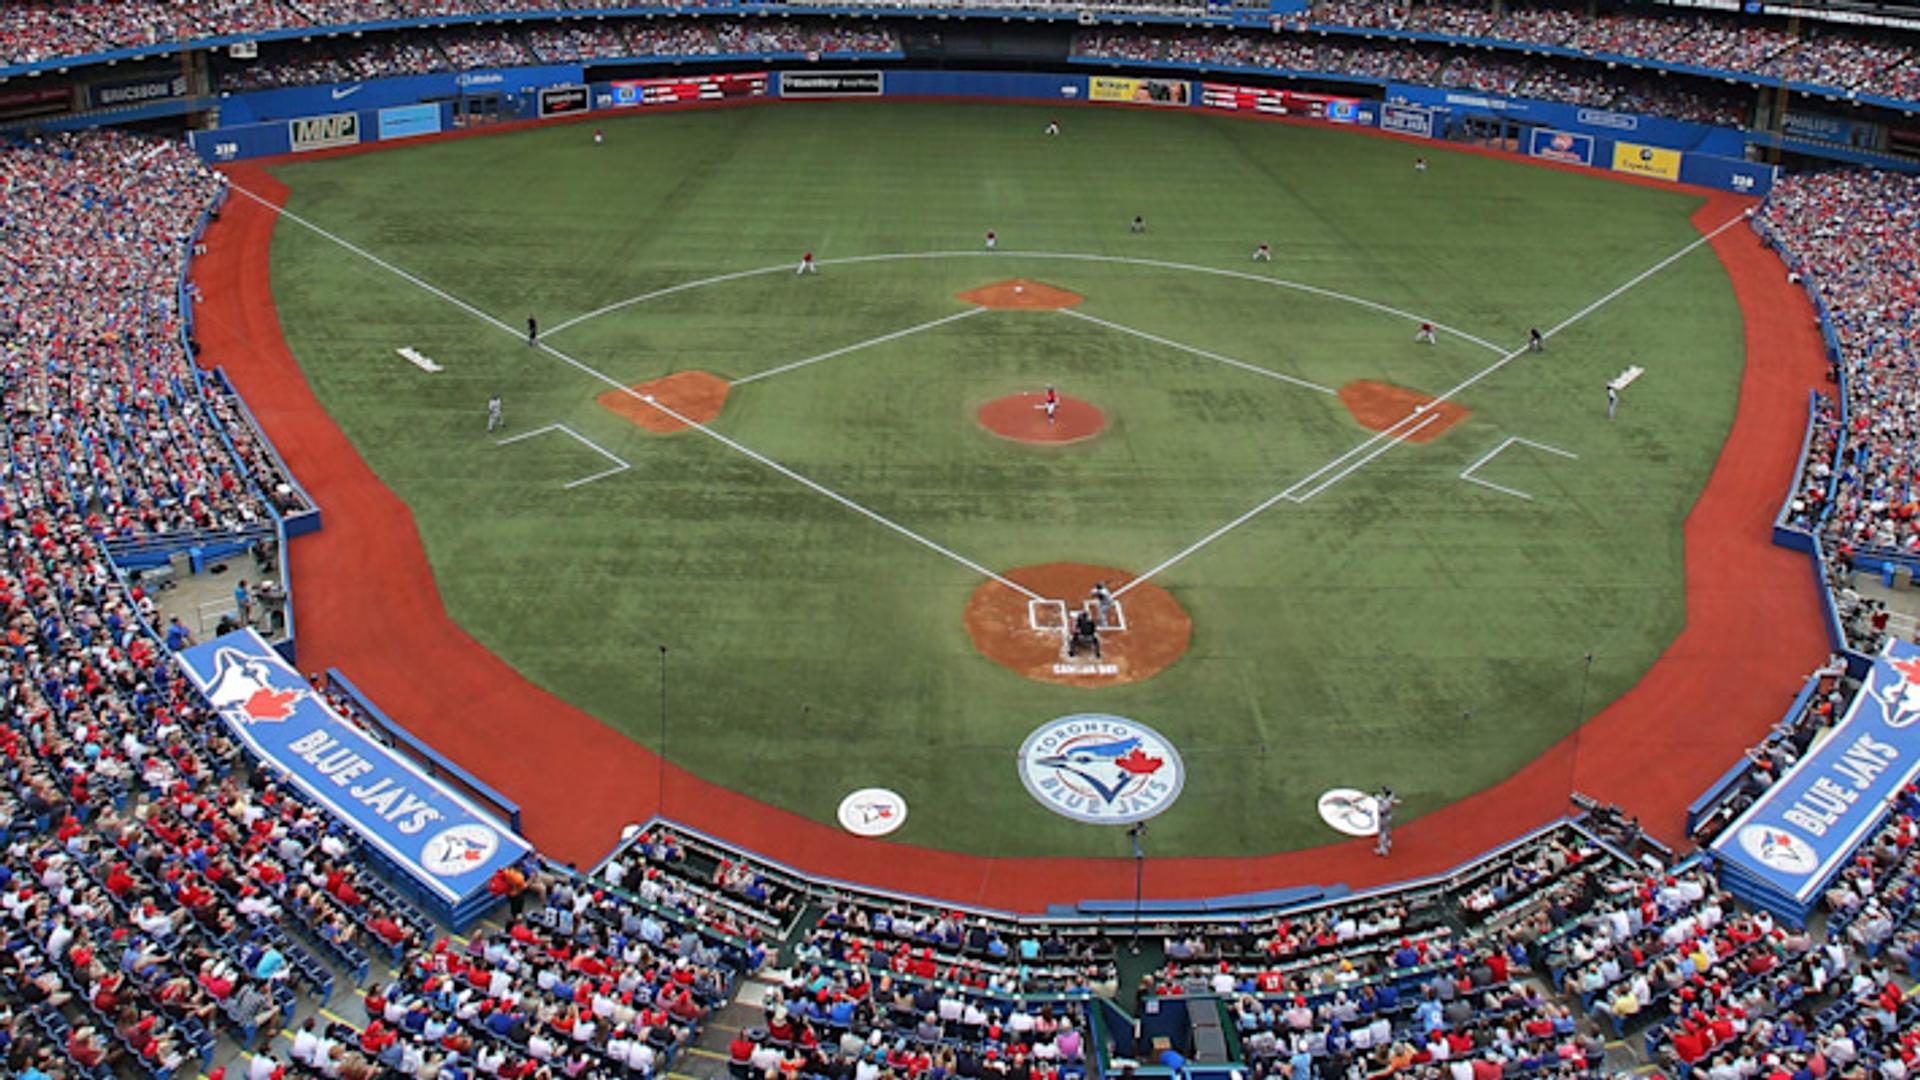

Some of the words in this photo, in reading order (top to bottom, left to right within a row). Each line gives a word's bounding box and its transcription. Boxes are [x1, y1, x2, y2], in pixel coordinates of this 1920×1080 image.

[101, 83, 168, 102] ERICSSON
[298, 115, 354, 143] MNP
[1781, 113, 1840, 134] PHILIPS
[1037, 724, 1127, 753] TORONTO
[288, 729, 374, 785] BLUE
[350, 776, 438, 835] JAYS
[1040, 775, 1101, 814] BLUE
[1117, 780, 1168, 814] JAYS
[1783, 777, 1859, 837] BLUE
[1833, 732, 1899, 790] JAYS
